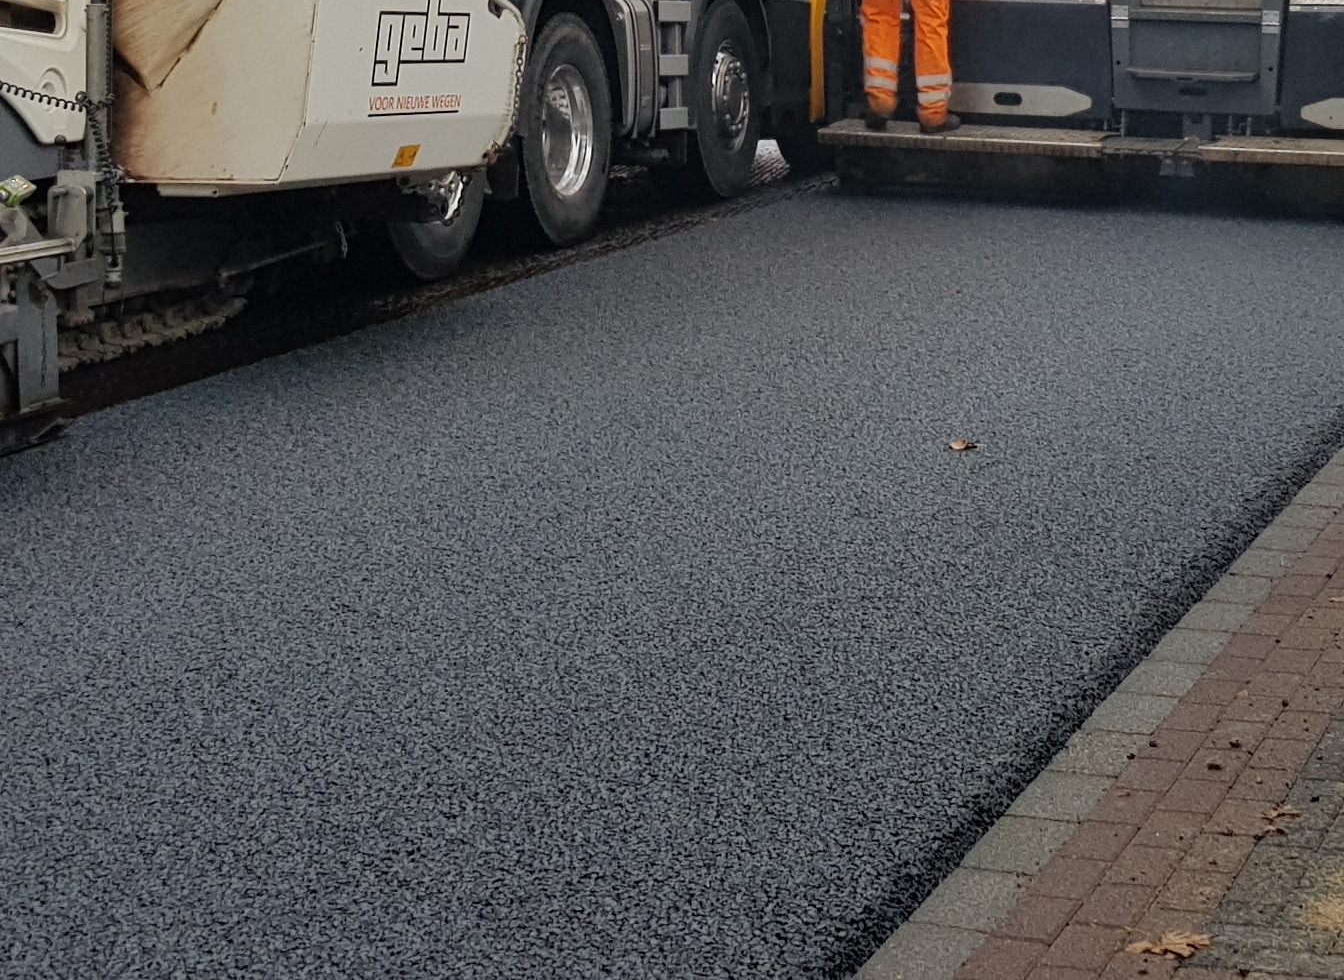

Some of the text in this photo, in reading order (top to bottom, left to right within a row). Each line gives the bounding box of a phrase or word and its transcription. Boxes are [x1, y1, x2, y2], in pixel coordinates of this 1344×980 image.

[369, 93, 462, 111] VOOR NIEUWE WEGEN
